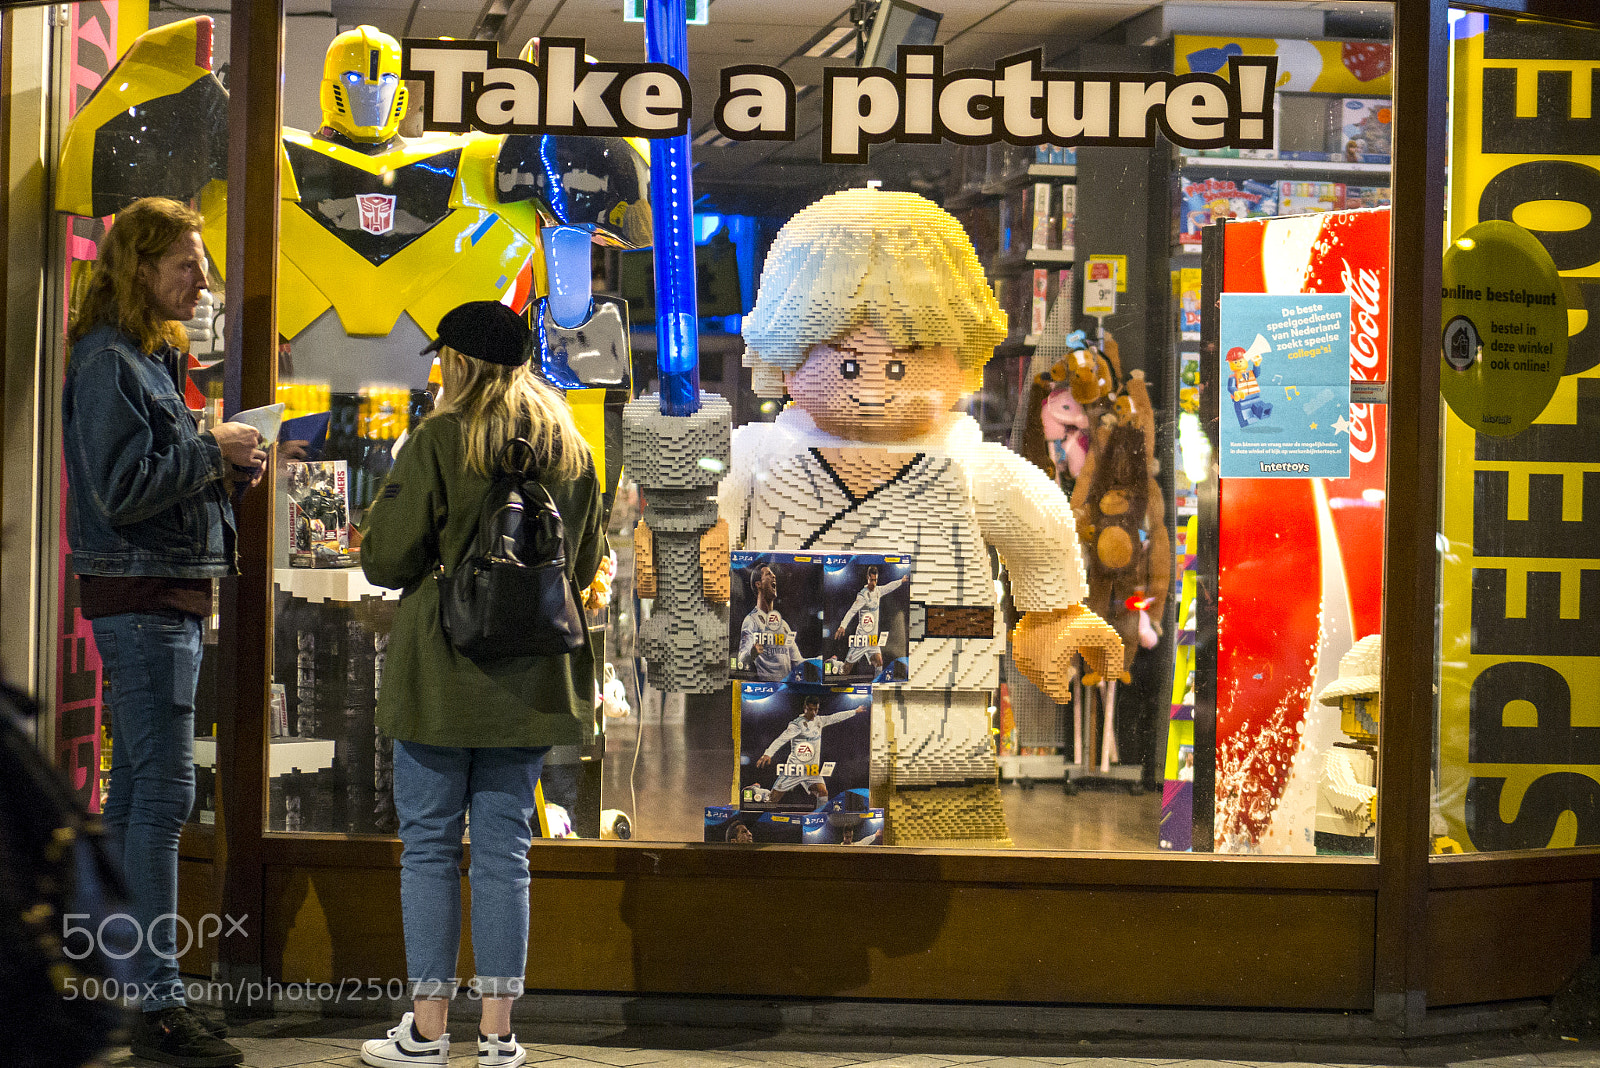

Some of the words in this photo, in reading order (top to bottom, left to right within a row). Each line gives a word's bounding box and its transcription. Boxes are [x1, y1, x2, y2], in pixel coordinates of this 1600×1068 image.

[406, 42, 687, 134] Take
[719, 69, 791, 136] a
[827, 49, 1272, 158] picture!
[1442, 284, 1482, 300] online
[1486, 287, 1556, 307] bestelpunt
[1281, 308, 1295, 318] De
[1296, 304, 1323, 314] beste
[1266, 312, 1342, 332] speelgoedketen
[1491, 321, 1523, 334] bestel
[1526, 323, 1537, 335] in
[1272, 331, 1289, 341] van
[1290, 321, 1341, 338] Nederland
[1276, 339, 1303, 351] zoekt
[1304, 333, 1340, 349] speelse
[1490, 340, 1515, 352] deze
[1518, 342, 1553, 354] winkel
[1287, 344, 1332, 360] collega's!
[1490, 358, 1510, 370] ook
[1513, 359, 1550, 372] online!
[1259, 461, 1310, 473] Intertoys
[768, 614, 779, 623] EA
[863, 616, 873, 624] EA
[753, 631, 773, 645] FIFA
[774, 633, 784, 646] 18
[848, 634, 868, 648] FIFA
[868, 634, 878, 646] 18
[798, 745, 812, 753] EA
[776, 763, 804, 777] FIFA
[804, 763, 819, 777] 18
